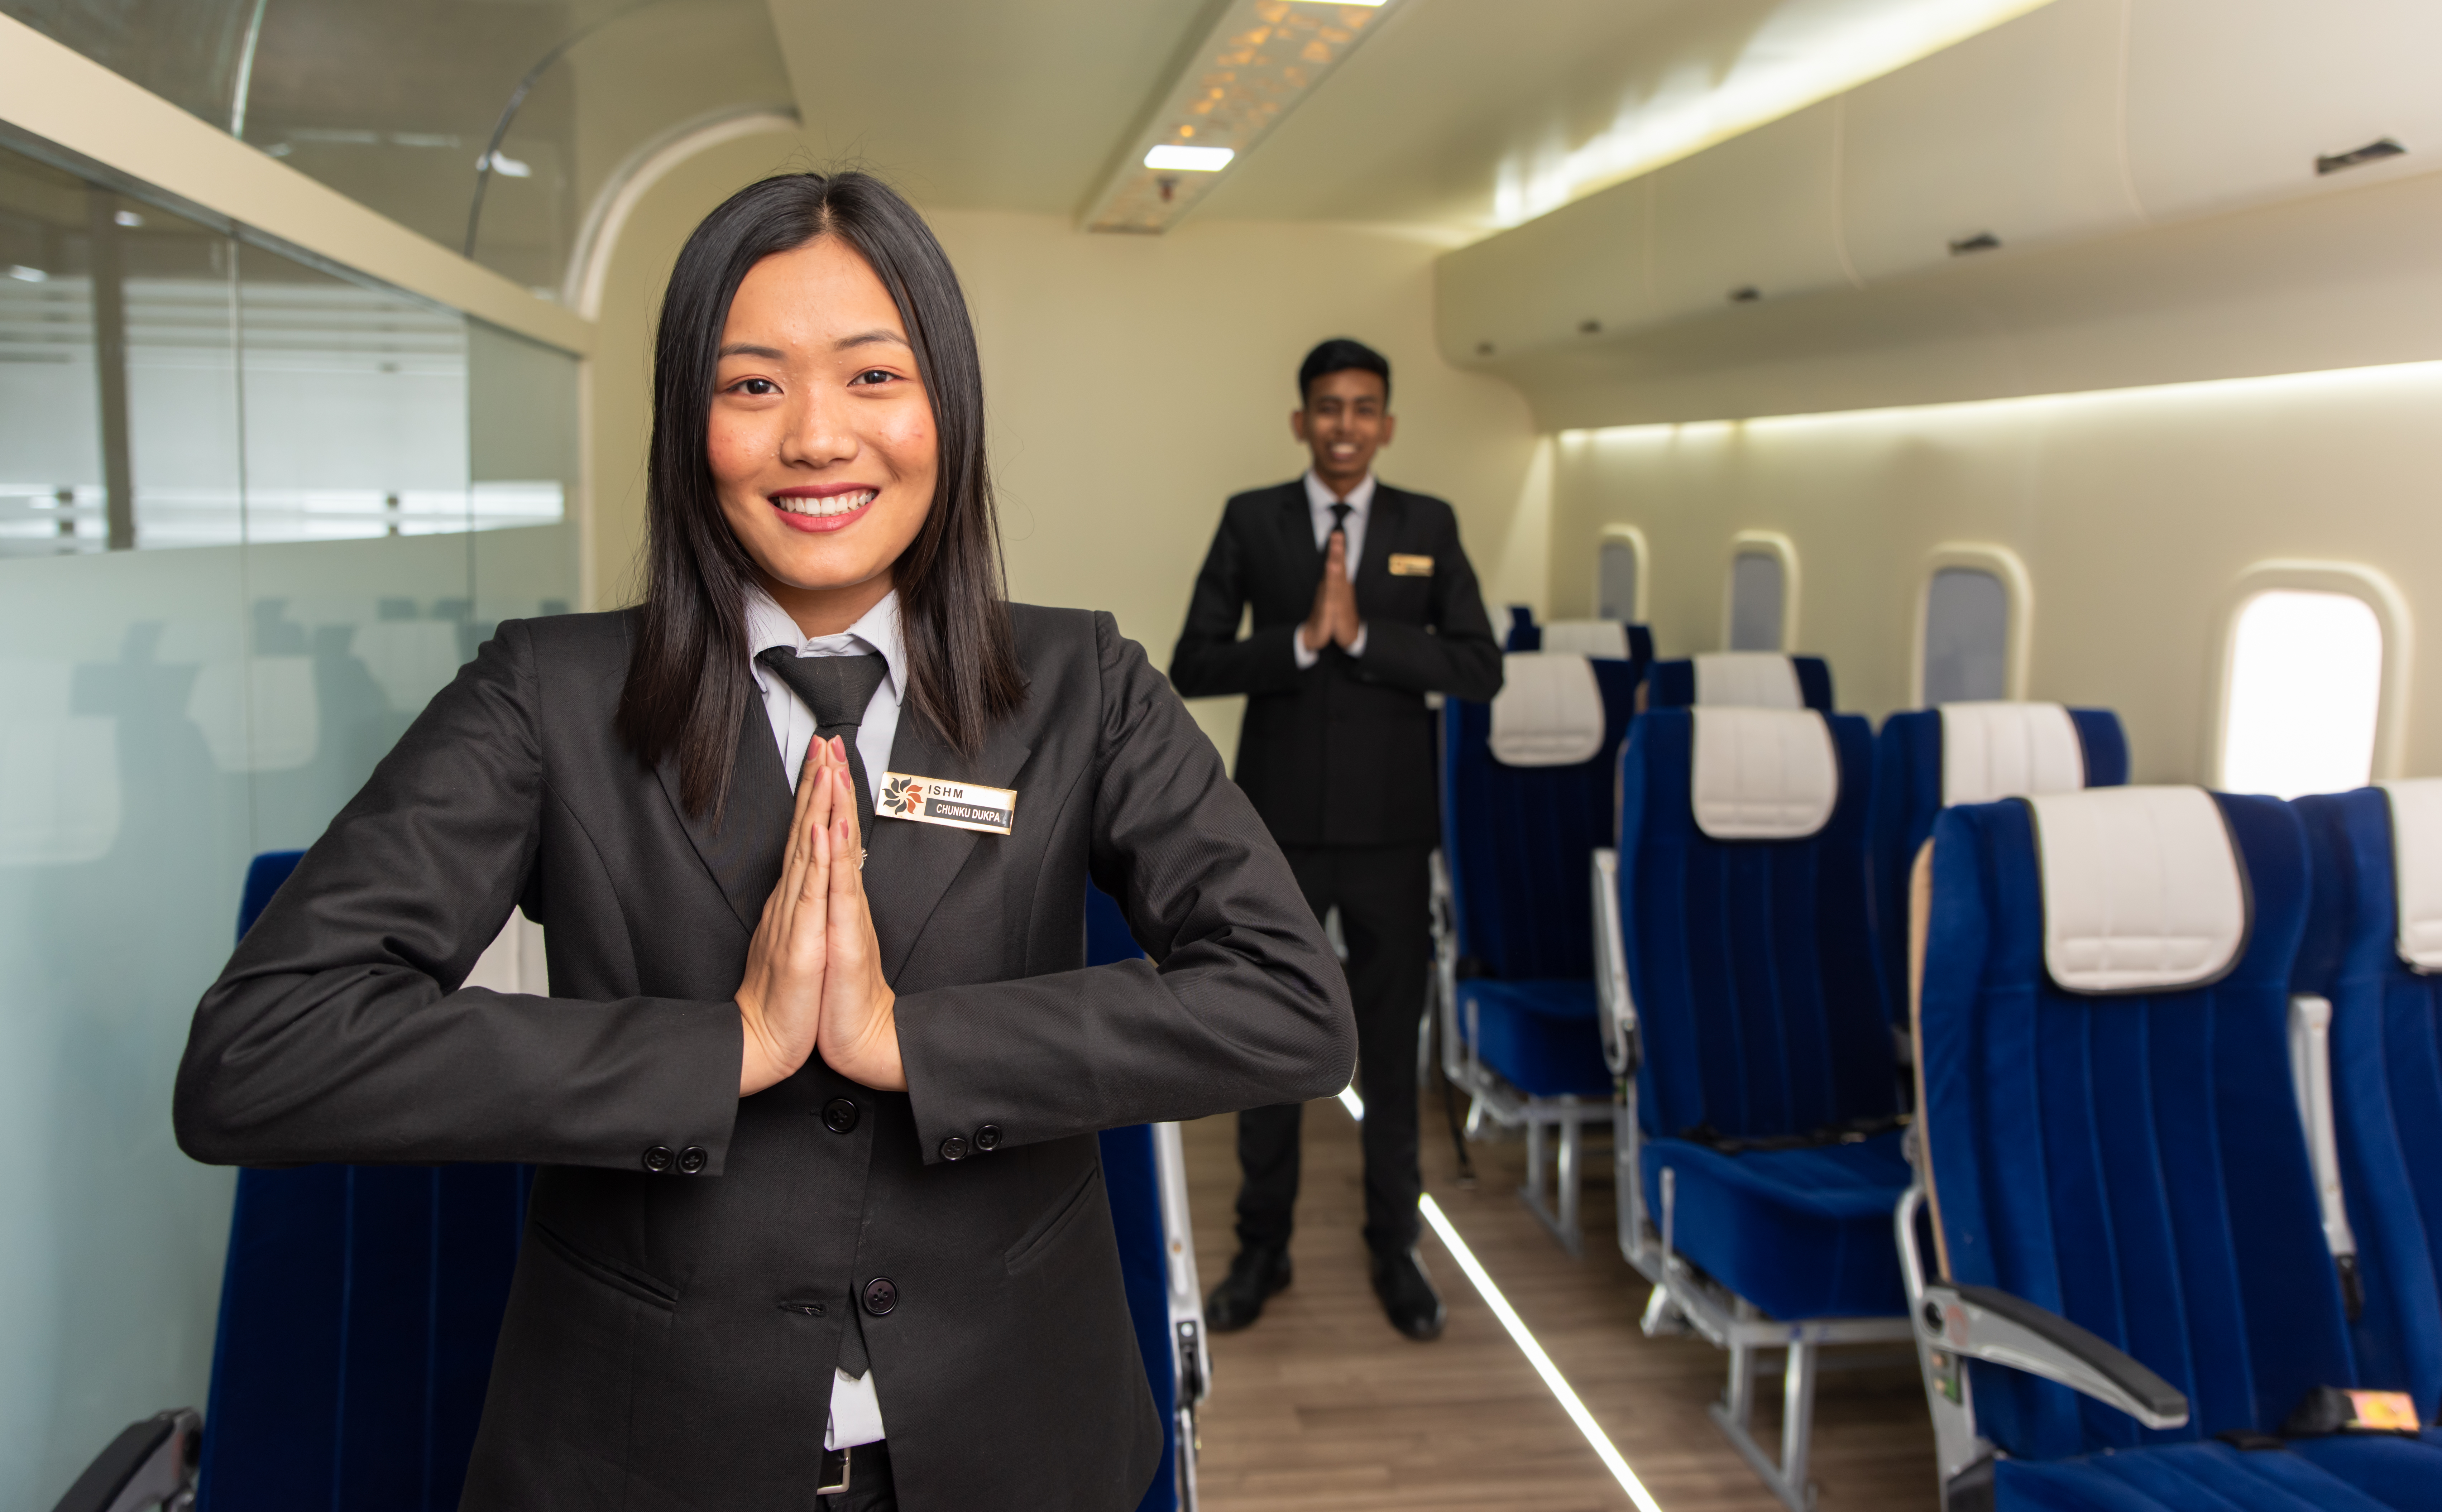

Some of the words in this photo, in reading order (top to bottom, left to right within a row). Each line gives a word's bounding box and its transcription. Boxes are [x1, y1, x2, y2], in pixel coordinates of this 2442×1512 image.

[928, 785, 963, 798] ISHM
[936, 804, 970, 818] CHUNKU
[972, 809, 1000, 822] DUKPA
